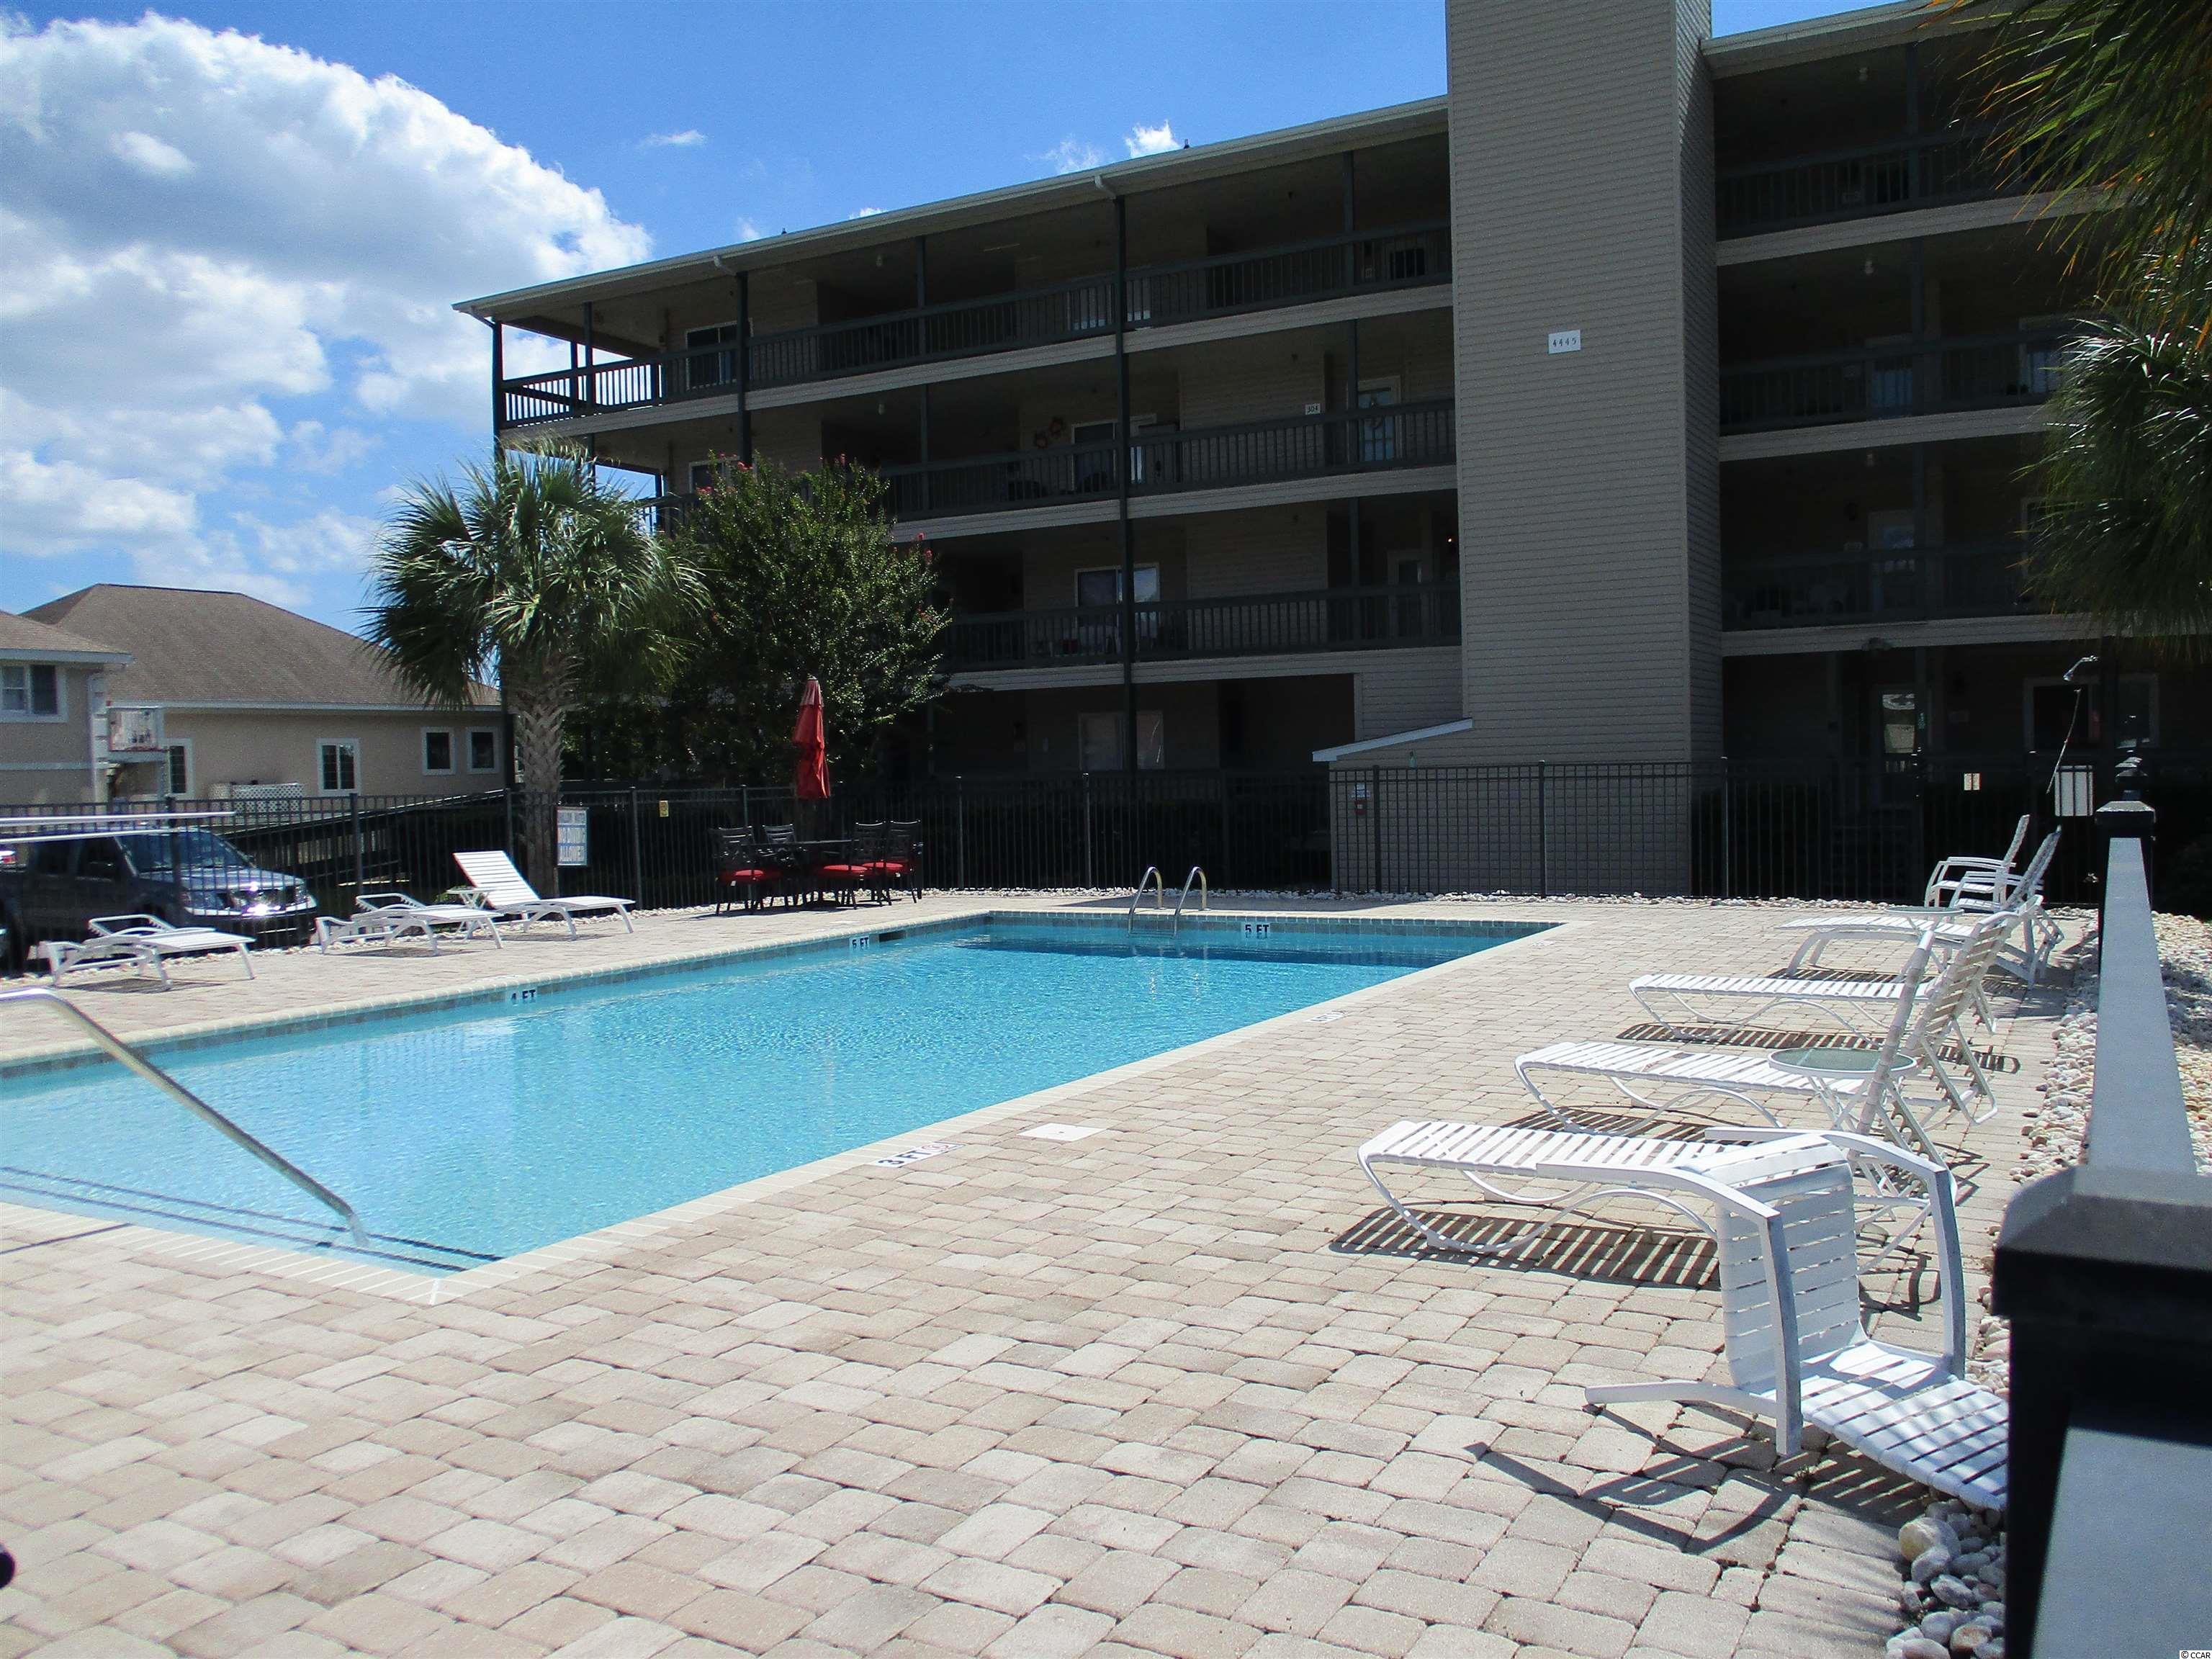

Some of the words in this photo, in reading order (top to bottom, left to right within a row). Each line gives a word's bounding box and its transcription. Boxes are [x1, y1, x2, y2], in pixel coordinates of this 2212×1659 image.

[1552, 337, 1577, 347] 4445
[1244, 924, 1251, 934] 5
[1256, 924, 1269, 935] FT
[860, 937, 869, 948] FT
